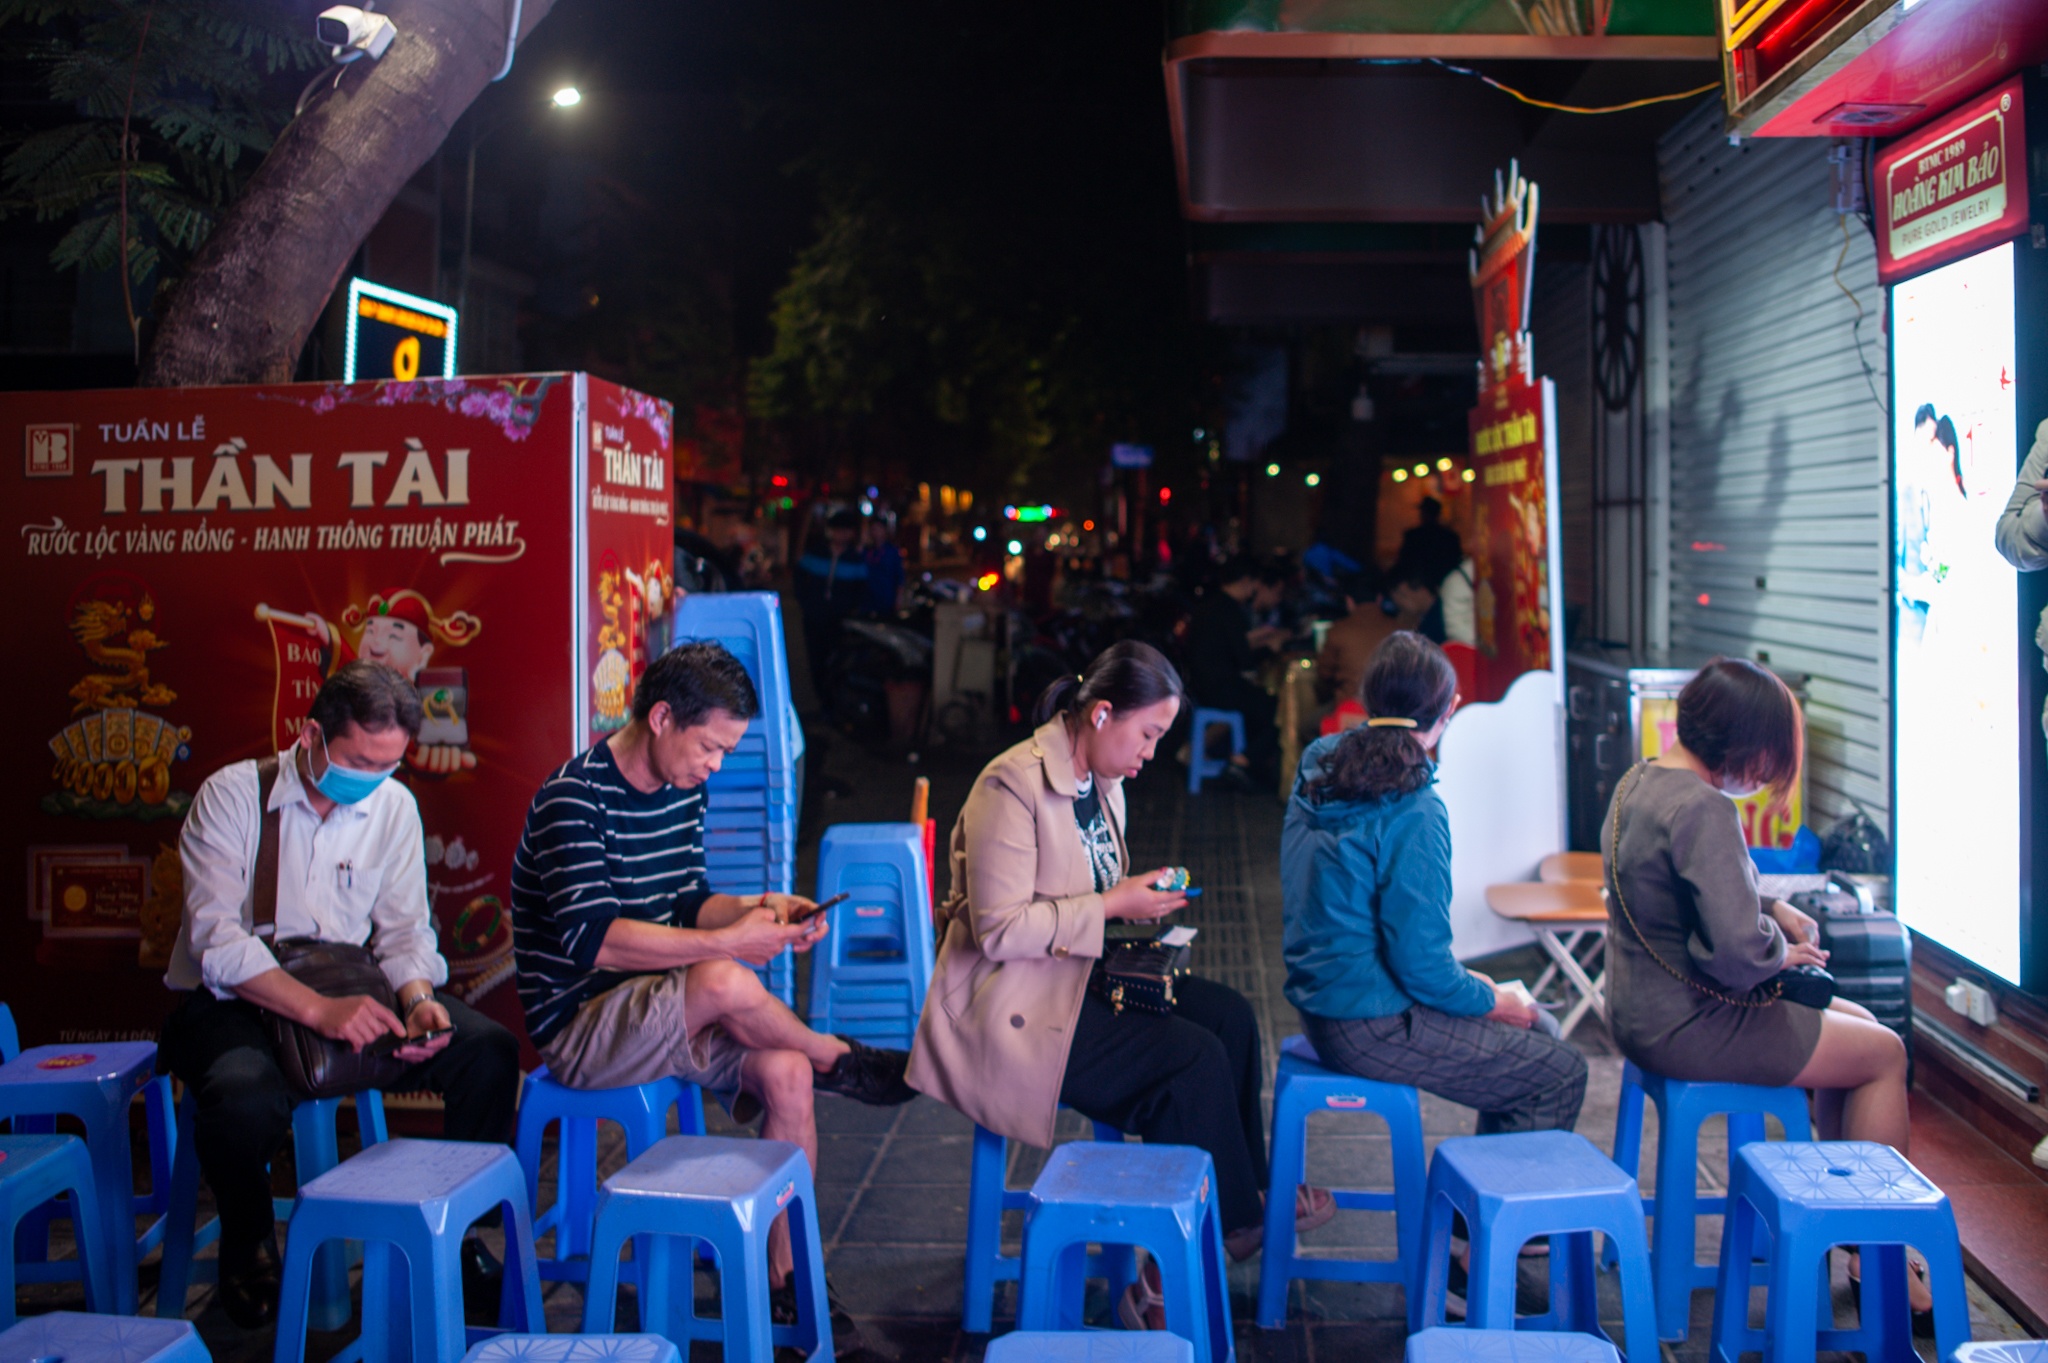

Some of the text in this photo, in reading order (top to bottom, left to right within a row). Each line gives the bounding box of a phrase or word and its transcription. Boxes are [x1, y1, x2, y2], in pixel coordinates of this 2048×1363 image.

[1893, 141, 1999, 222] HOÀNG KIM BẢO
[1918, 150, 1943, 175] BTMC
[1901, 197, 1991, 246] PURE GOLD JEWELRY
[176, 413, 207, 441] LỄ
[91, 436, 470, 514] THẦN TÀI
[26, 520, 82, 556] RƯỚC
[84, 524, 121, 560] LỘC
[125, 521, 177, 554] VÀNG
[181, 516, 236, 553] RỒNG
[253, 526, 311, 551] HANH
[316, 519, 384, 550] THÔNG
[390, 517, 459, 554] THUẬN
[463, 515, 520, 547] PHÁT
